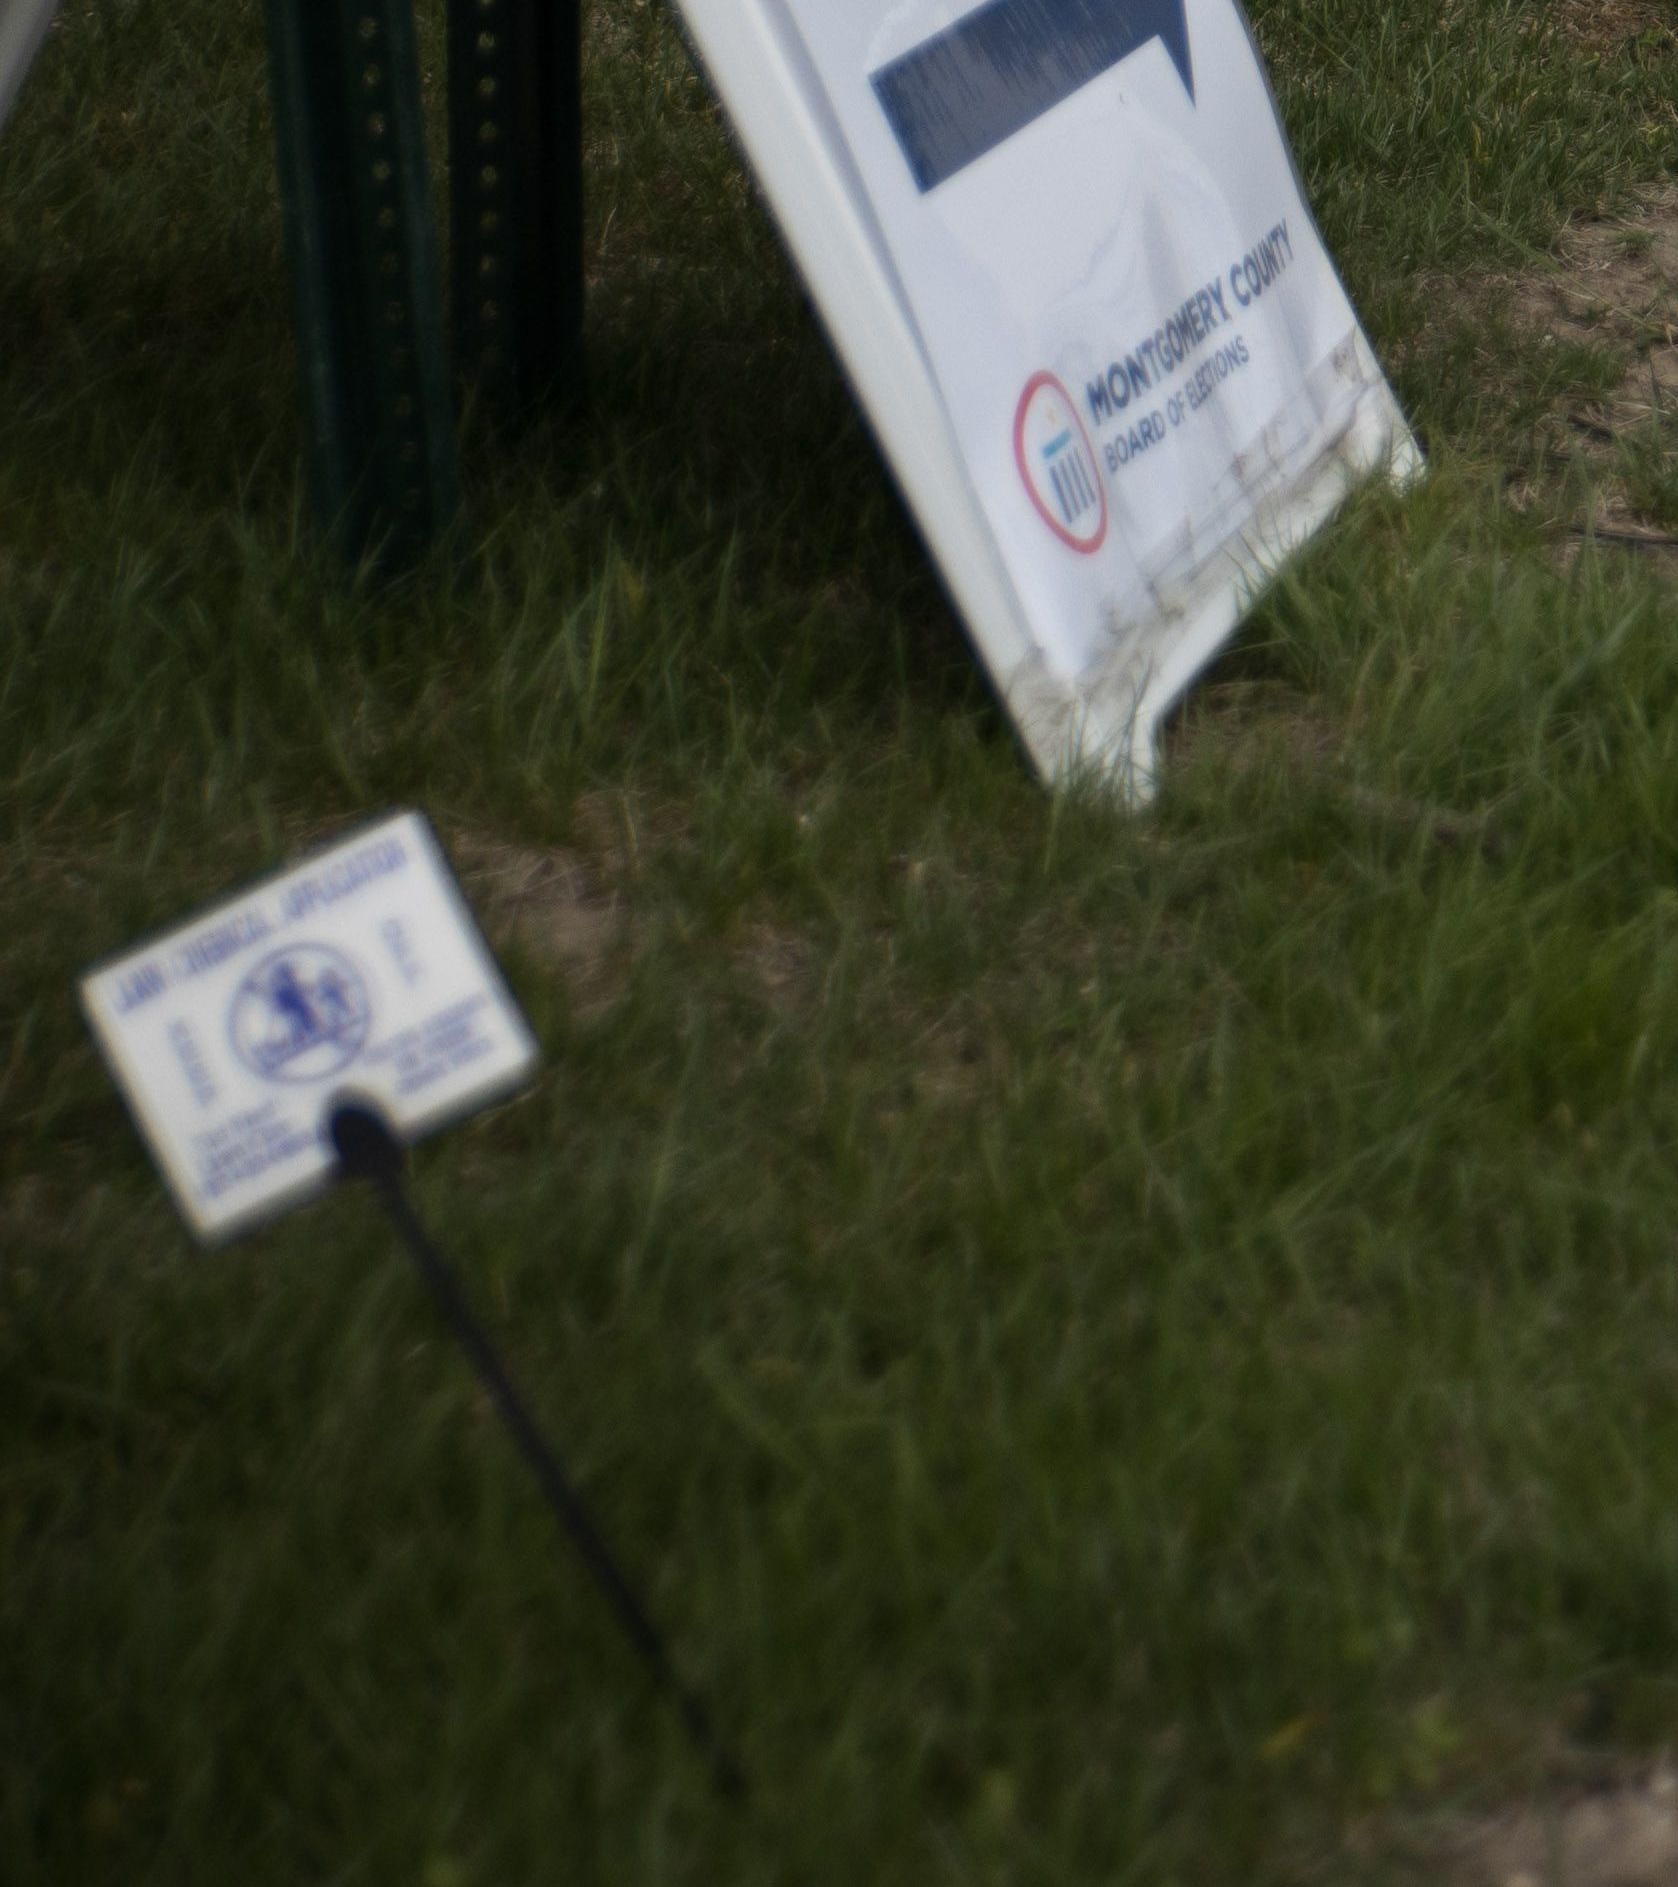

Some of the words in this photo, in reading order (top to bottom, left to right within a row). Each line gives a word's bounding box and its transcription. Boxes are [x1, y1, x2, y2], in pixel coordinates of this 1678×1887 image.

[1086, 274, 1233, 427] MONTGOMERY
[1228, 217, 1295, 307] COUNTY
[1103, 409, 1167, 473] BOARD
[1166, 390, 1187, 427] OF
[1184, 335, 1250, 411] ELECTIONS
